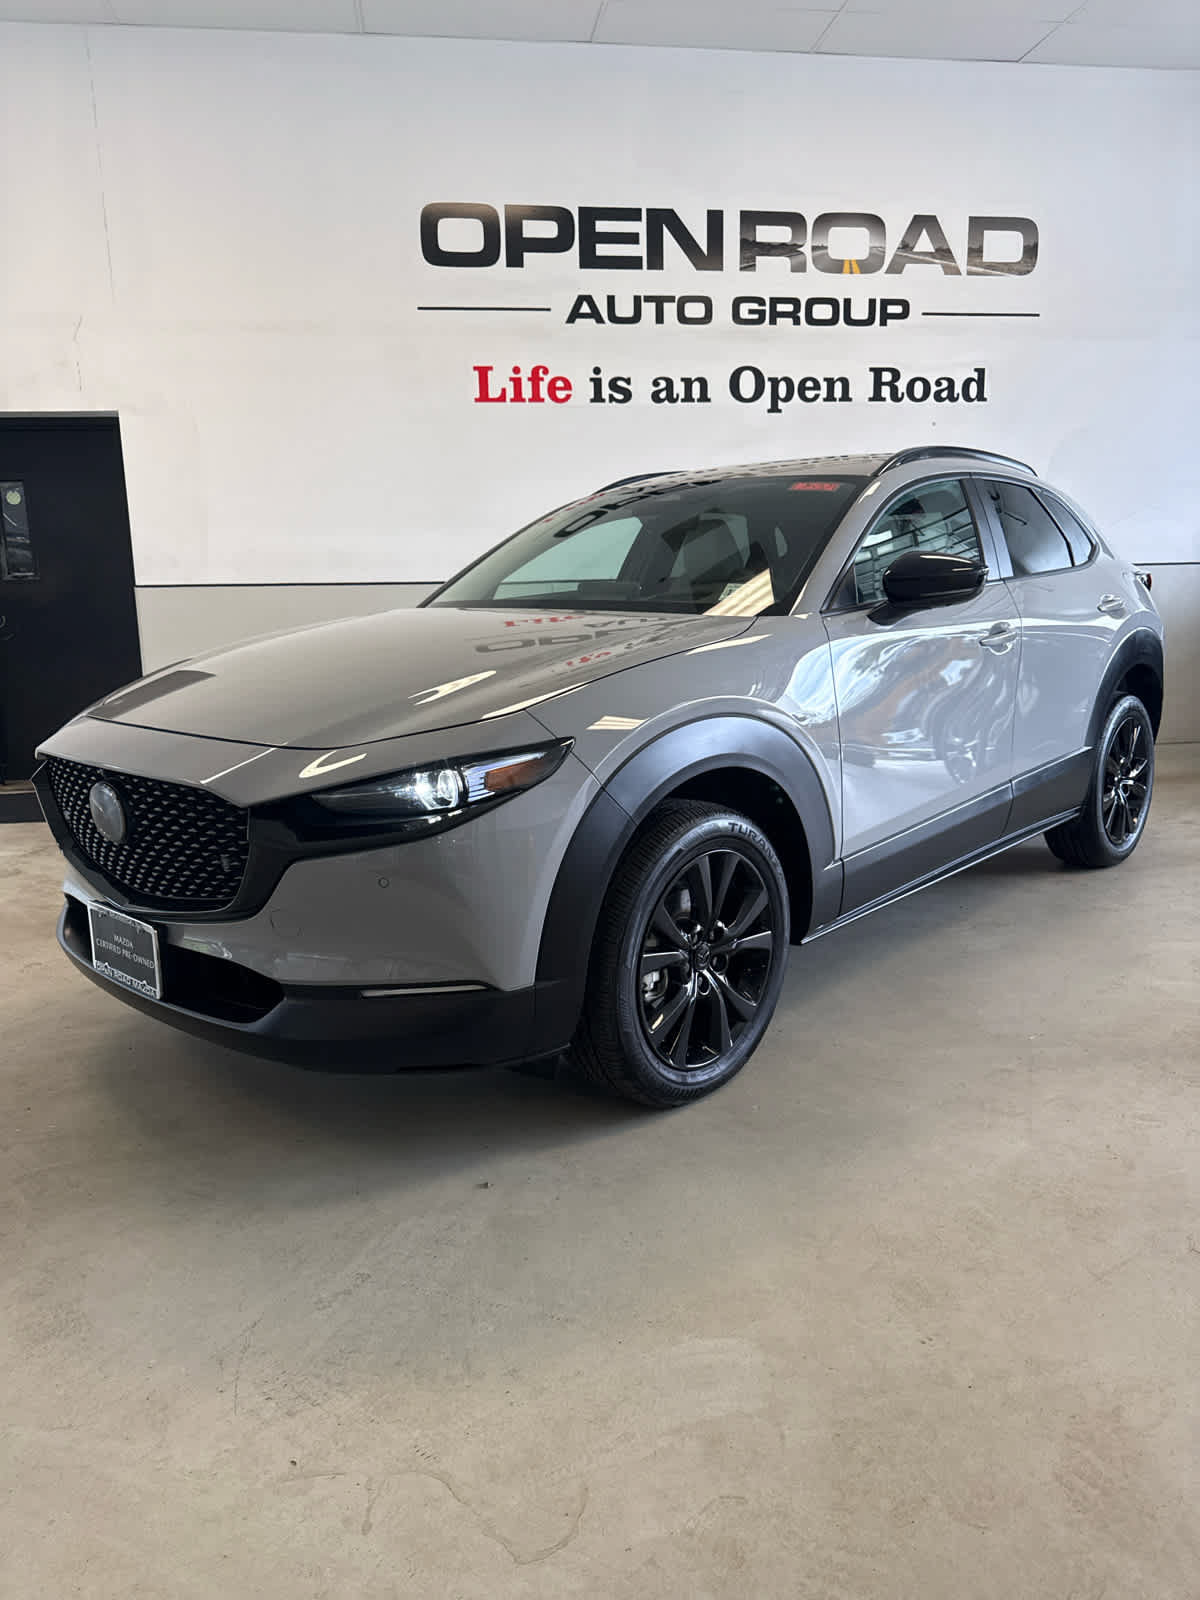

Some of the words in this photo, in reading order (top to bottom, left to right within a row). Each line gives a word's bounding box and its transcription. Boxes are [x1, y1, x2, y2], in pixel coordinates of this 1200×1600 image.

[420, 202, 724, 272] OPEN
[739, 209, 1040, 277] ROAD
[565, 294, 713, 326] AUTO
[731, 296, 911, 327] GROUP
[472, 365, 573, 404] Life
[588, 366, 633, 405] is
[650, 376, 712, 405] an
[728, 365, 853, 414] Open
[867, 367, 988, 405] Road
